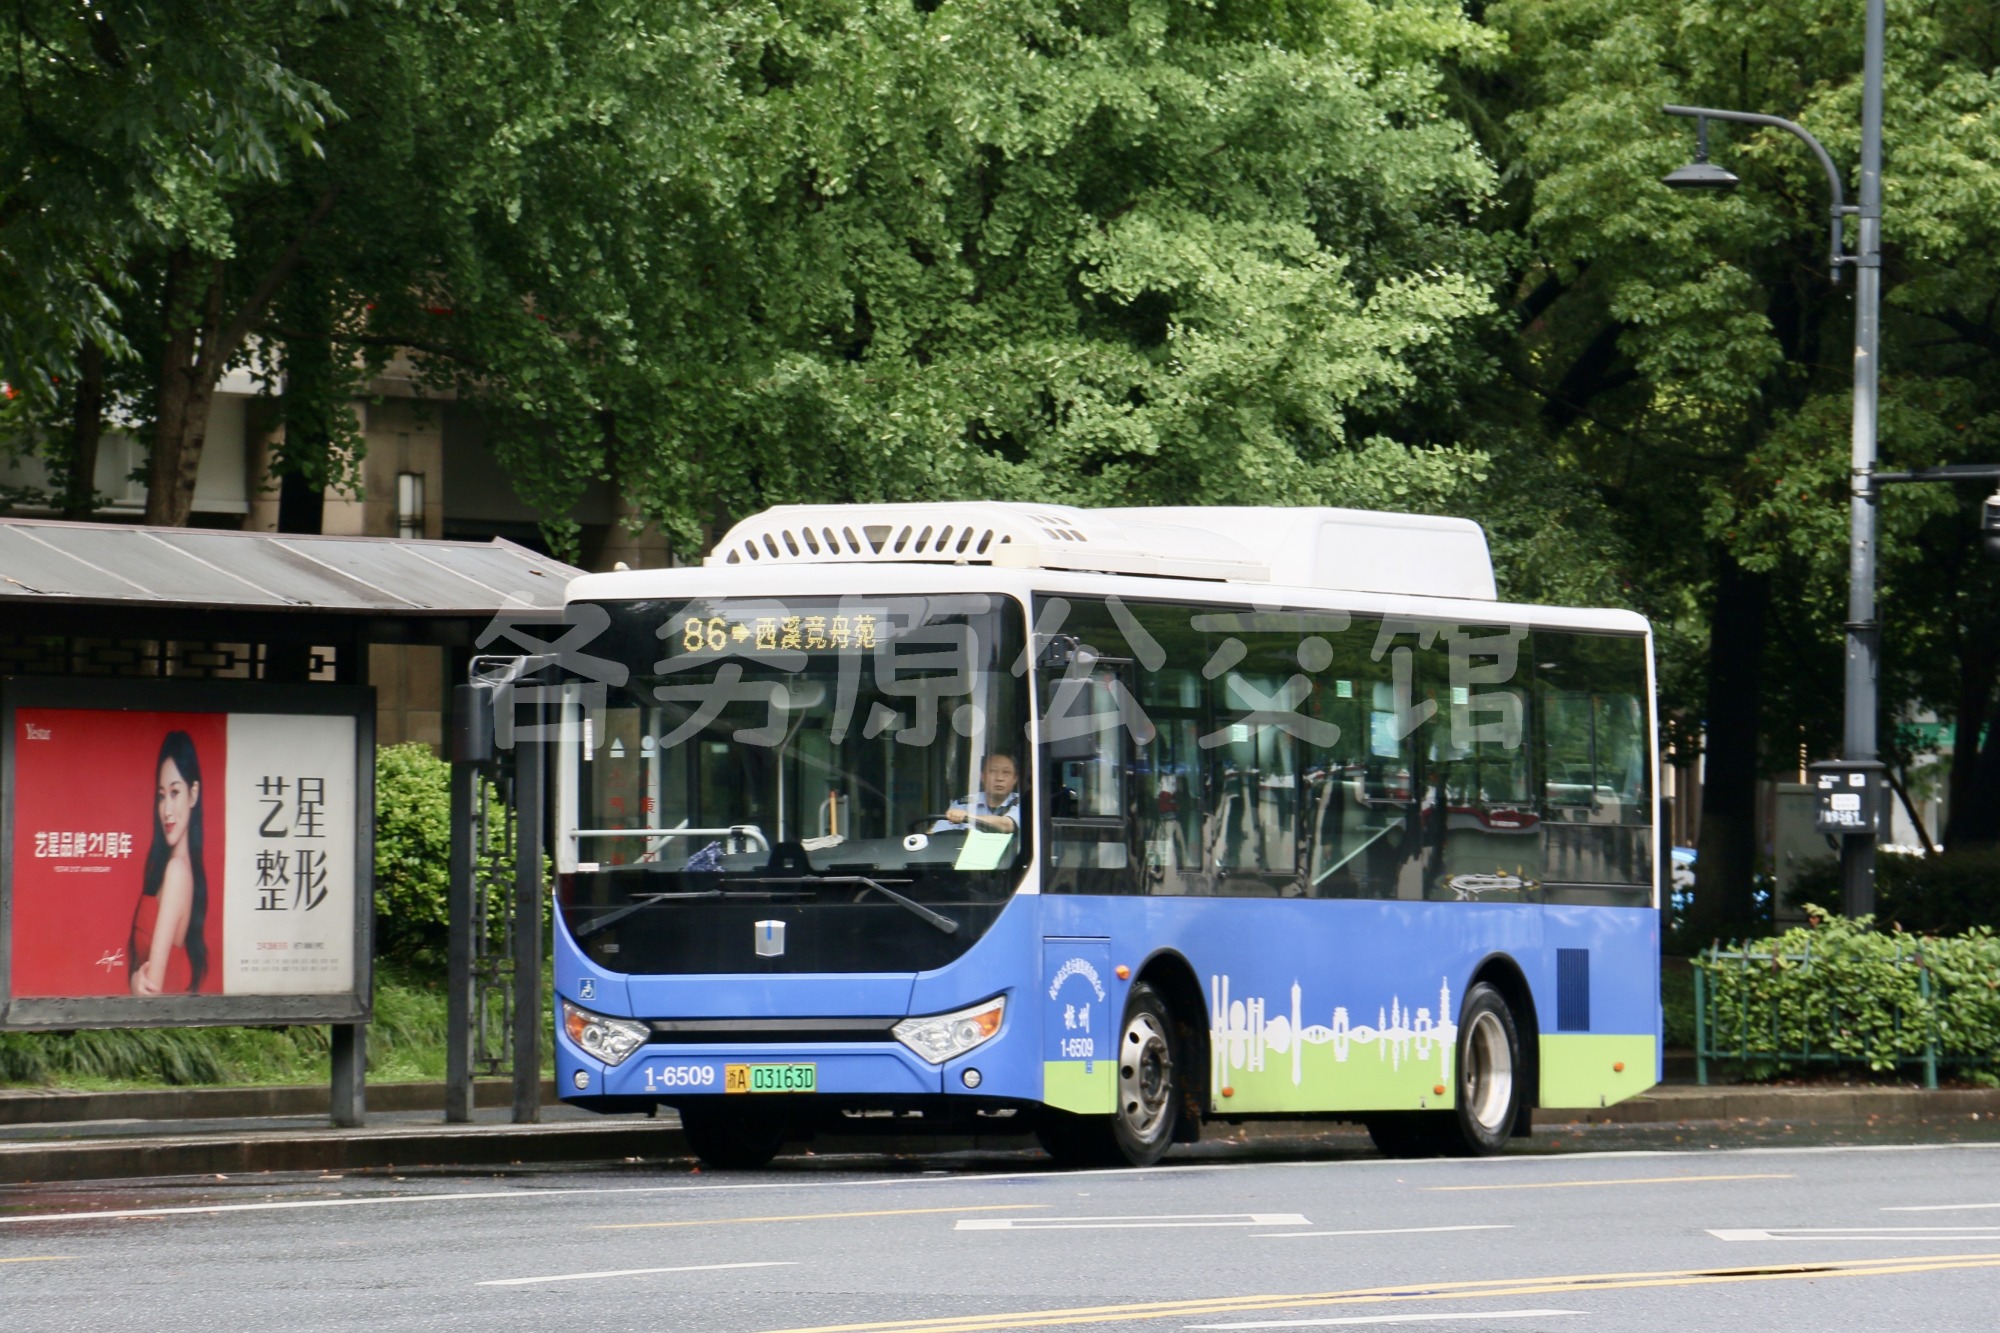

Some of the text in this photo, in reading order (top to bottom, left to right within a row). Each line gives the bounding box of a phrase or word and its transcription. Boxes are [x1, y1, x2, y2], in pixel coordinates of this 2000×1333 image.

[683, 617, 727, 651] 86
[756, 615, 877, 650] 西溪竞舟苑
[255, 775, 326, 838] 艺星
[34, 831, 133, 859] 艺星品牌21周年
[253, 849, 328, 912] 整形
[1060, 1038, 1094, 1058] 1-6509
[644, 1065, 715, 1086] 1-6509
[754, 1068, 814, 1089] 03163D
